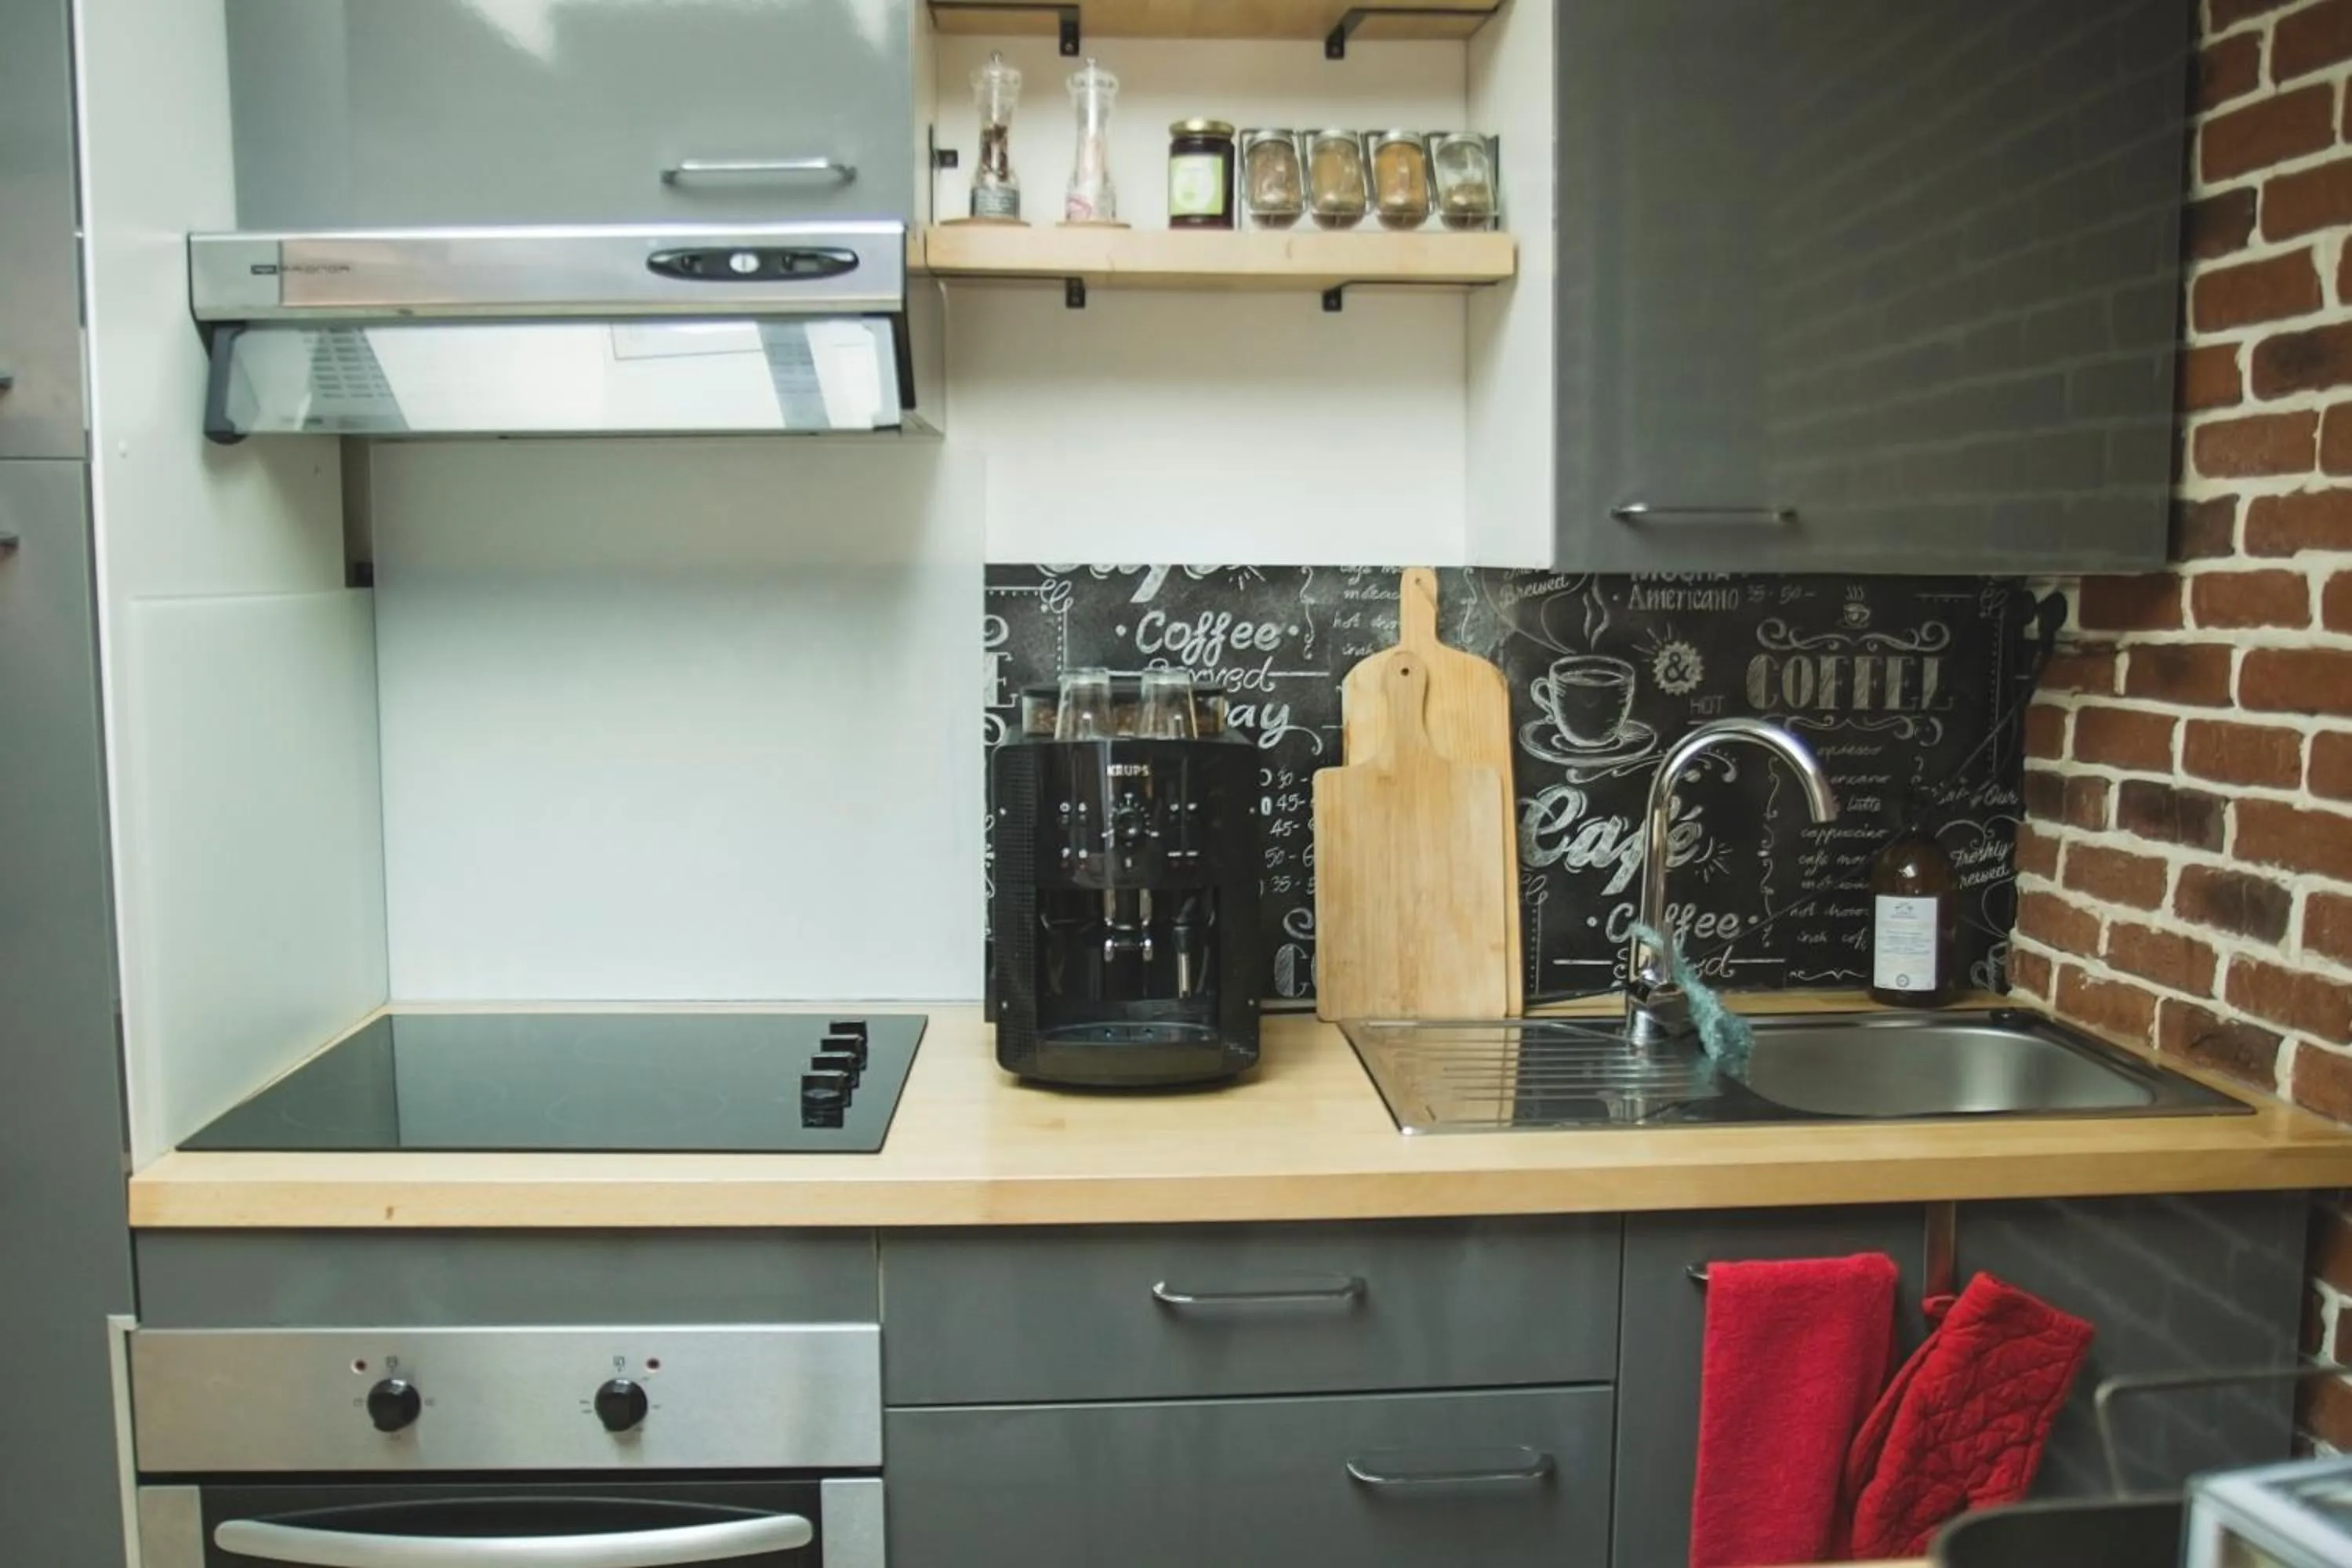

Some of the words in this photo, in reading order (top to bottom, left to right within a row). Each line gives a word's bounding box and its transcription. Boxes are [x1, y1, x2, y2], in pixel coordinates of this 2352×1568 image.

[1628, 583, 1739, 611] Americano
[1134, 610, 1282, 666] Coffee
[1746, 653, 1955, 710] COFFEE
[1689, 695, 1725, 715] HOT
[1106, 764, 1150, 777] KRUPS
[1949, 840, 2015, 868] Freshly
